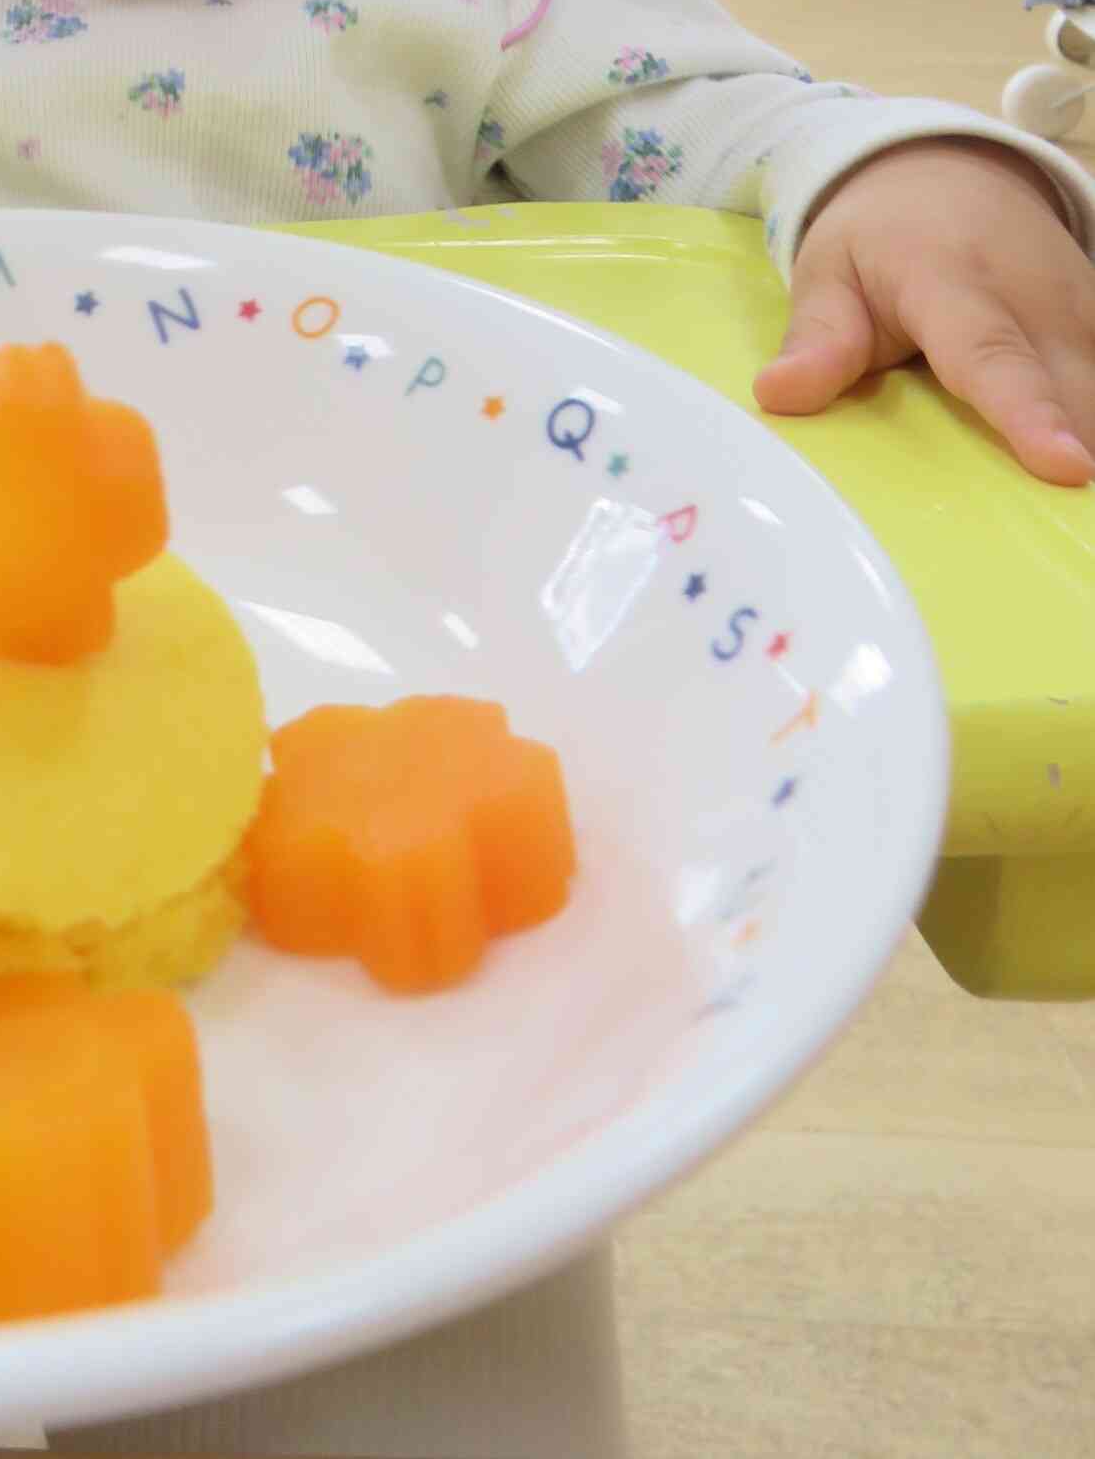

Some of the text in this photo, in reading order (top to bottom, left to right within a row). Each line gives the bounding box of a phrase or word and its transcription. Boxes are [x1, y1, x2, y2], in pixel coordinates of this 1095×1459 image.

[147, 288, 201, 344] N
[291, 295, 341, 339] O
[405, 356, 446, 396] P
[546, 399, 596, 461] Q
[711, 607, 759, 662] S
